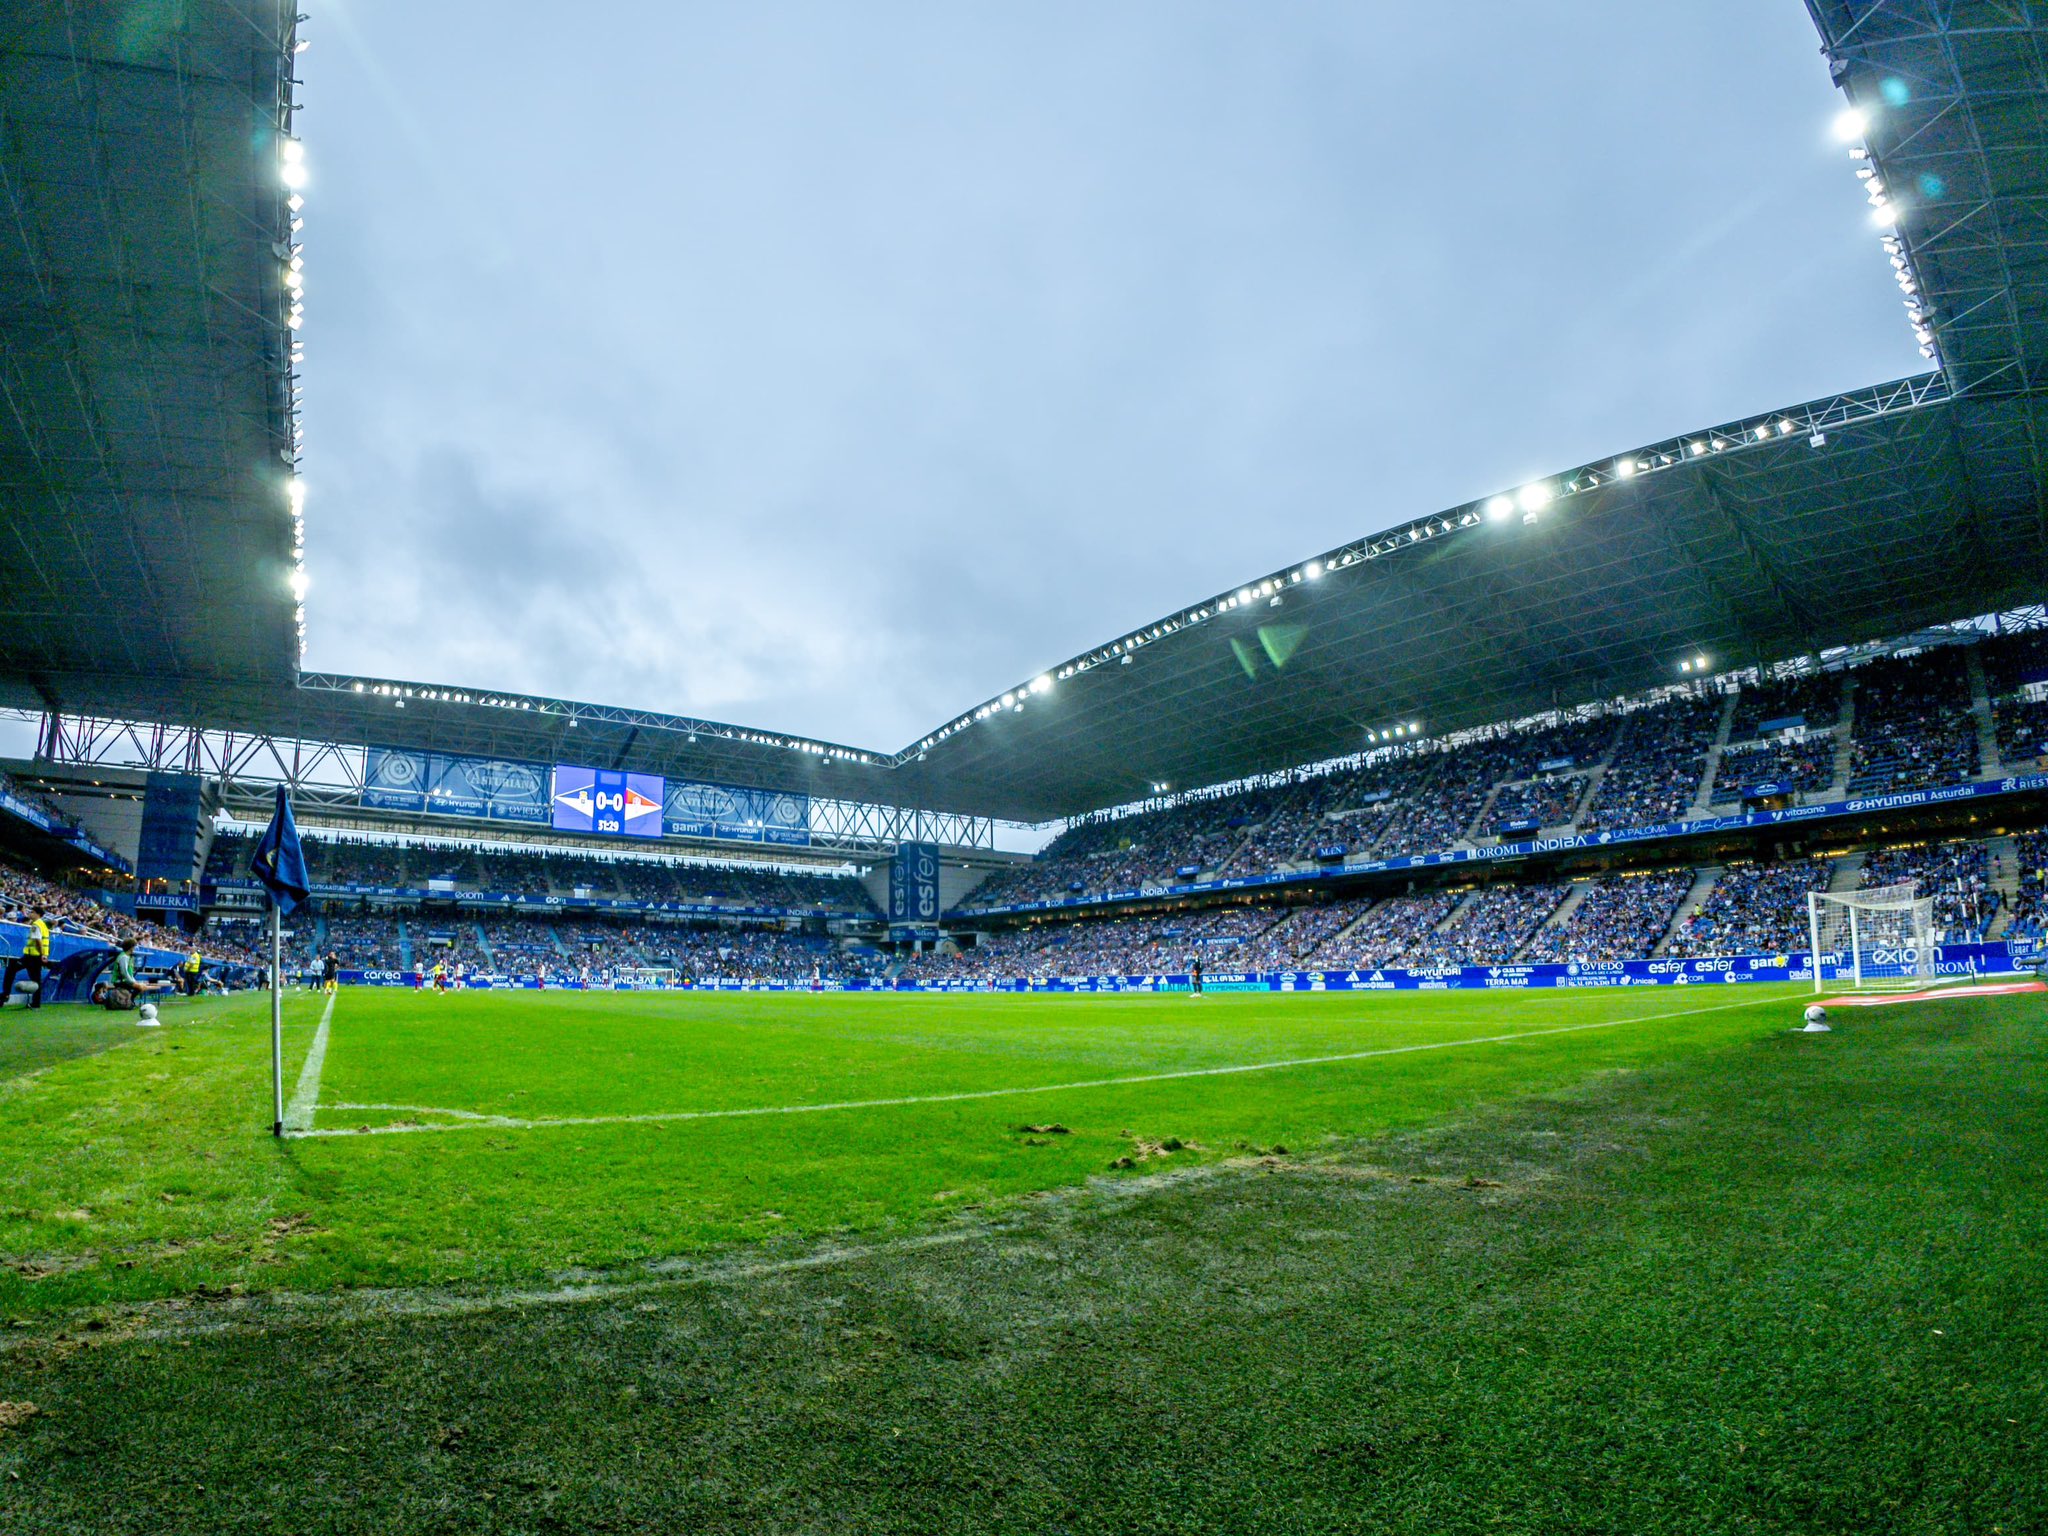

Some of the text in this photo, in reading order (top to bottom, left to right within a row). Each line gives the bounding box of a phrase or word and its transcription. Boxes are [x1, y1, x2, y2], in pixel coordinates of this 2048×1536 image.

[596, 791, 623, 811] 0-0
[1866, 785, 1975, 809] HYUNDAI Asturdai
[1785, 804, 1826, 818] vitasana
[1613, 830, 1625, 839] LA
[1627, 825, 1668, 836] PALOMA
[1532, 836, 1587, 852] INDIBA
[892, 859, 904, 915] esfer
[913, 846, 934, 916] esfer
[454, 891, 484, 900] exiom
[1140, 886, 1169, 896] INDIBA
[136, 895, 189, 907] ALIMERKA
[787, 909, 813, 917] INDIBA
[1581, 962, 1624, 971] OVIEDO
[1648, 959, 1686, 974] esfer
[1695, 957, 1735, 972] esfer
[363, 971, 400, 979] carrea
[1420, 968, 1461, 977] HYUNDAI
